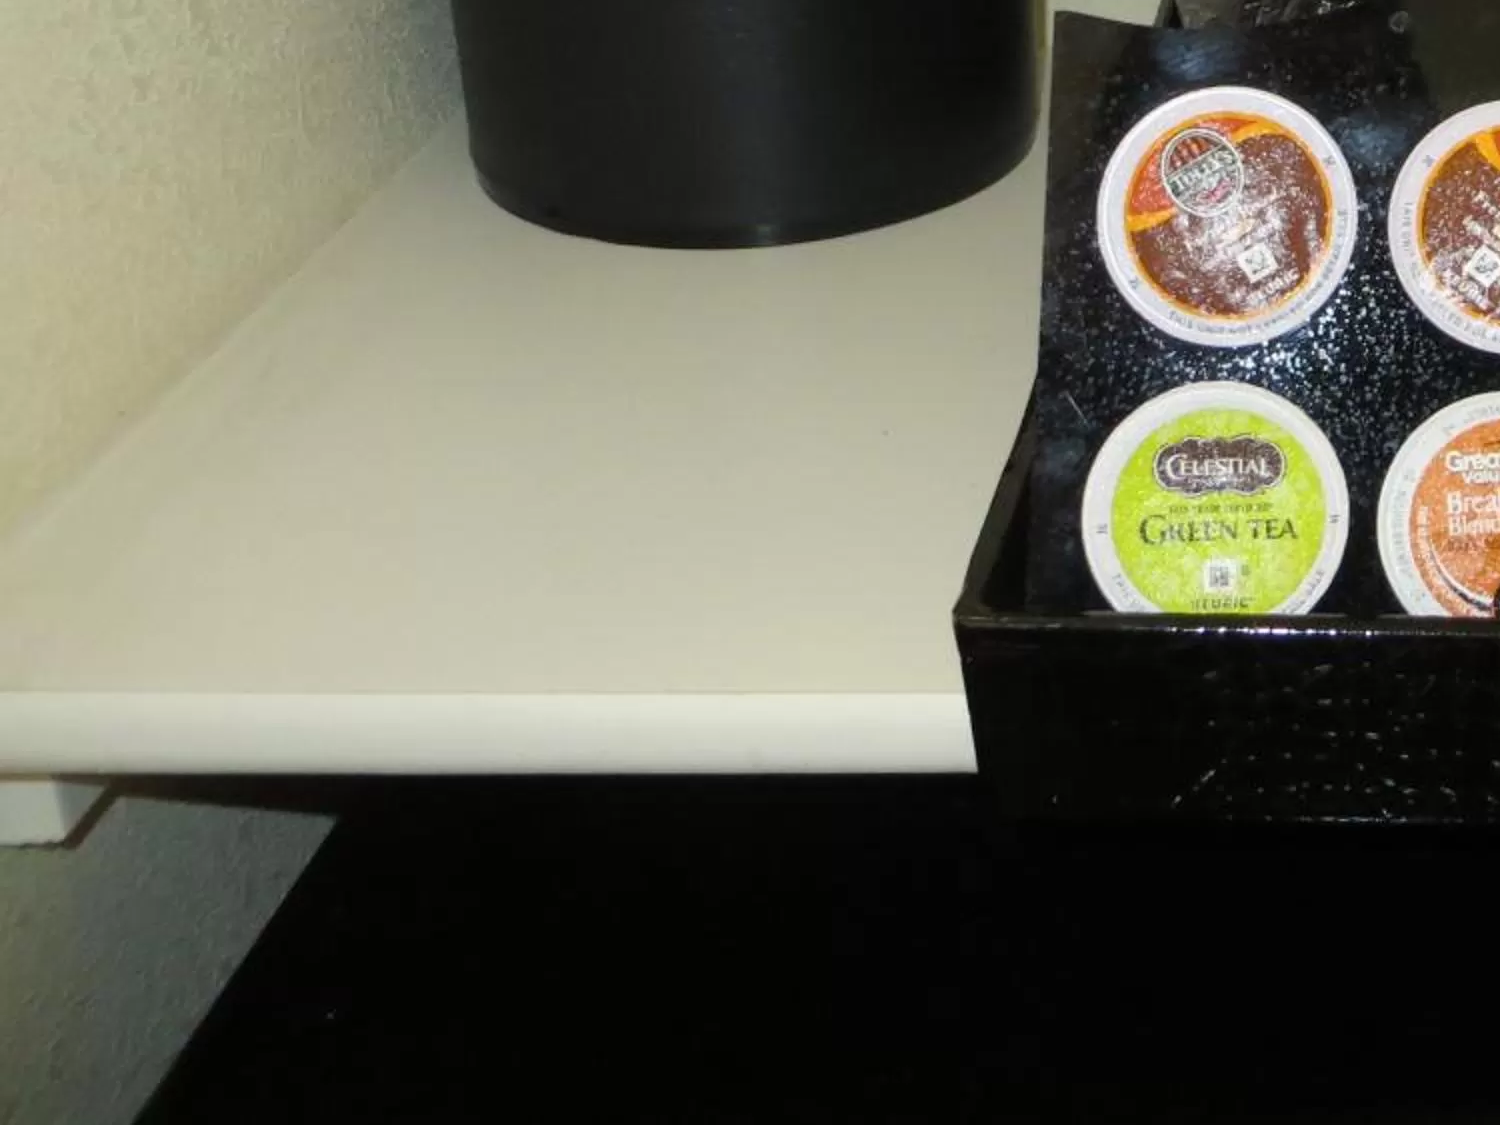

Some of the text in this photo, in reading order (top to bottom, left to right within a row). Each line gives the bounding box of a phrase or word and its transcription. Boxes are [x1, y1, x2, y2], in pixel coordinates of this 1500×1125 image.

[1166, 454, 1272, 481] CELESTIAL
[1139, 514, 1299, 545] GREEN TEA
